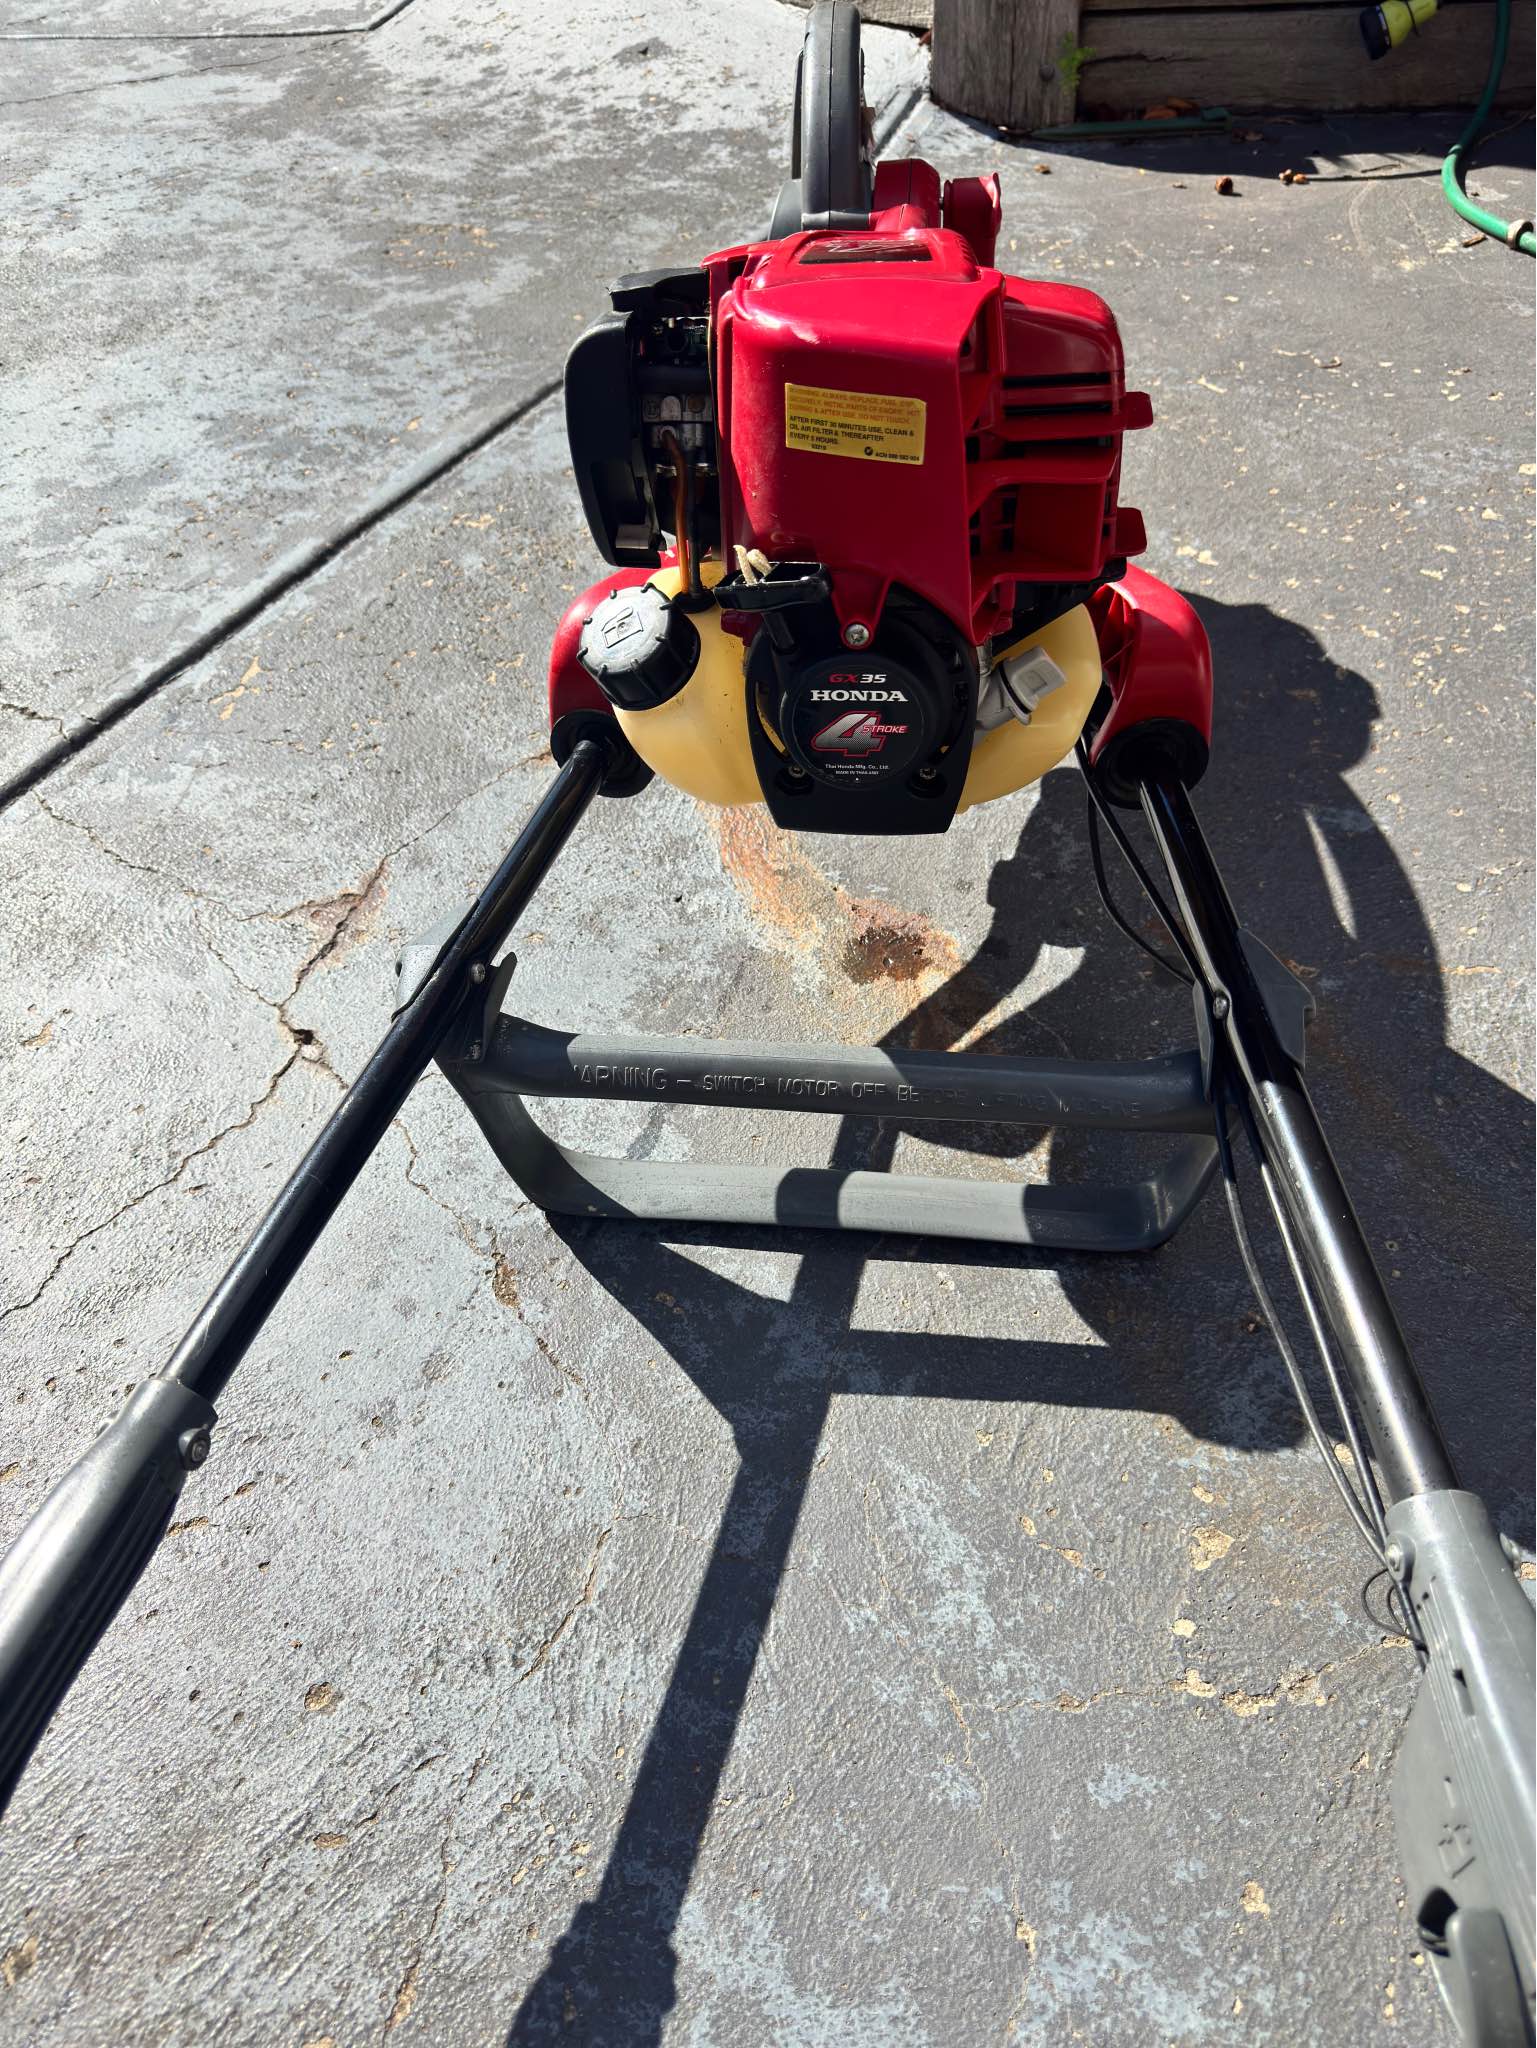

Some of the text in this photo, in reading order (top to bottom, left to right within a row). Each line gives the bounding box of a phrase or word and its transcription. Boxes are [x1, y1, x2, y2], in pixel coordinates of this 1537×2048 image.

[790, 416, 810, 424] AFTER
[810, 418, 828, 426] FIRST
[838, 422, 868, 432] MINUTES
[884, 428, 908, 436] CLEAN
[812, 427, 833, 435] FILTER
[790, 432, 810, 440] EVERY
[810, 690, 908, 702] HONDA
[810, 710, 909, 759] 4 STROKE
[572, 1064, 667, 1090] ARNING
[702, 1074, 767, 1094] SWITCH
[777, 1076, 840, 1097] MOTOR
[851, 1082, 888, 1100] OFF
